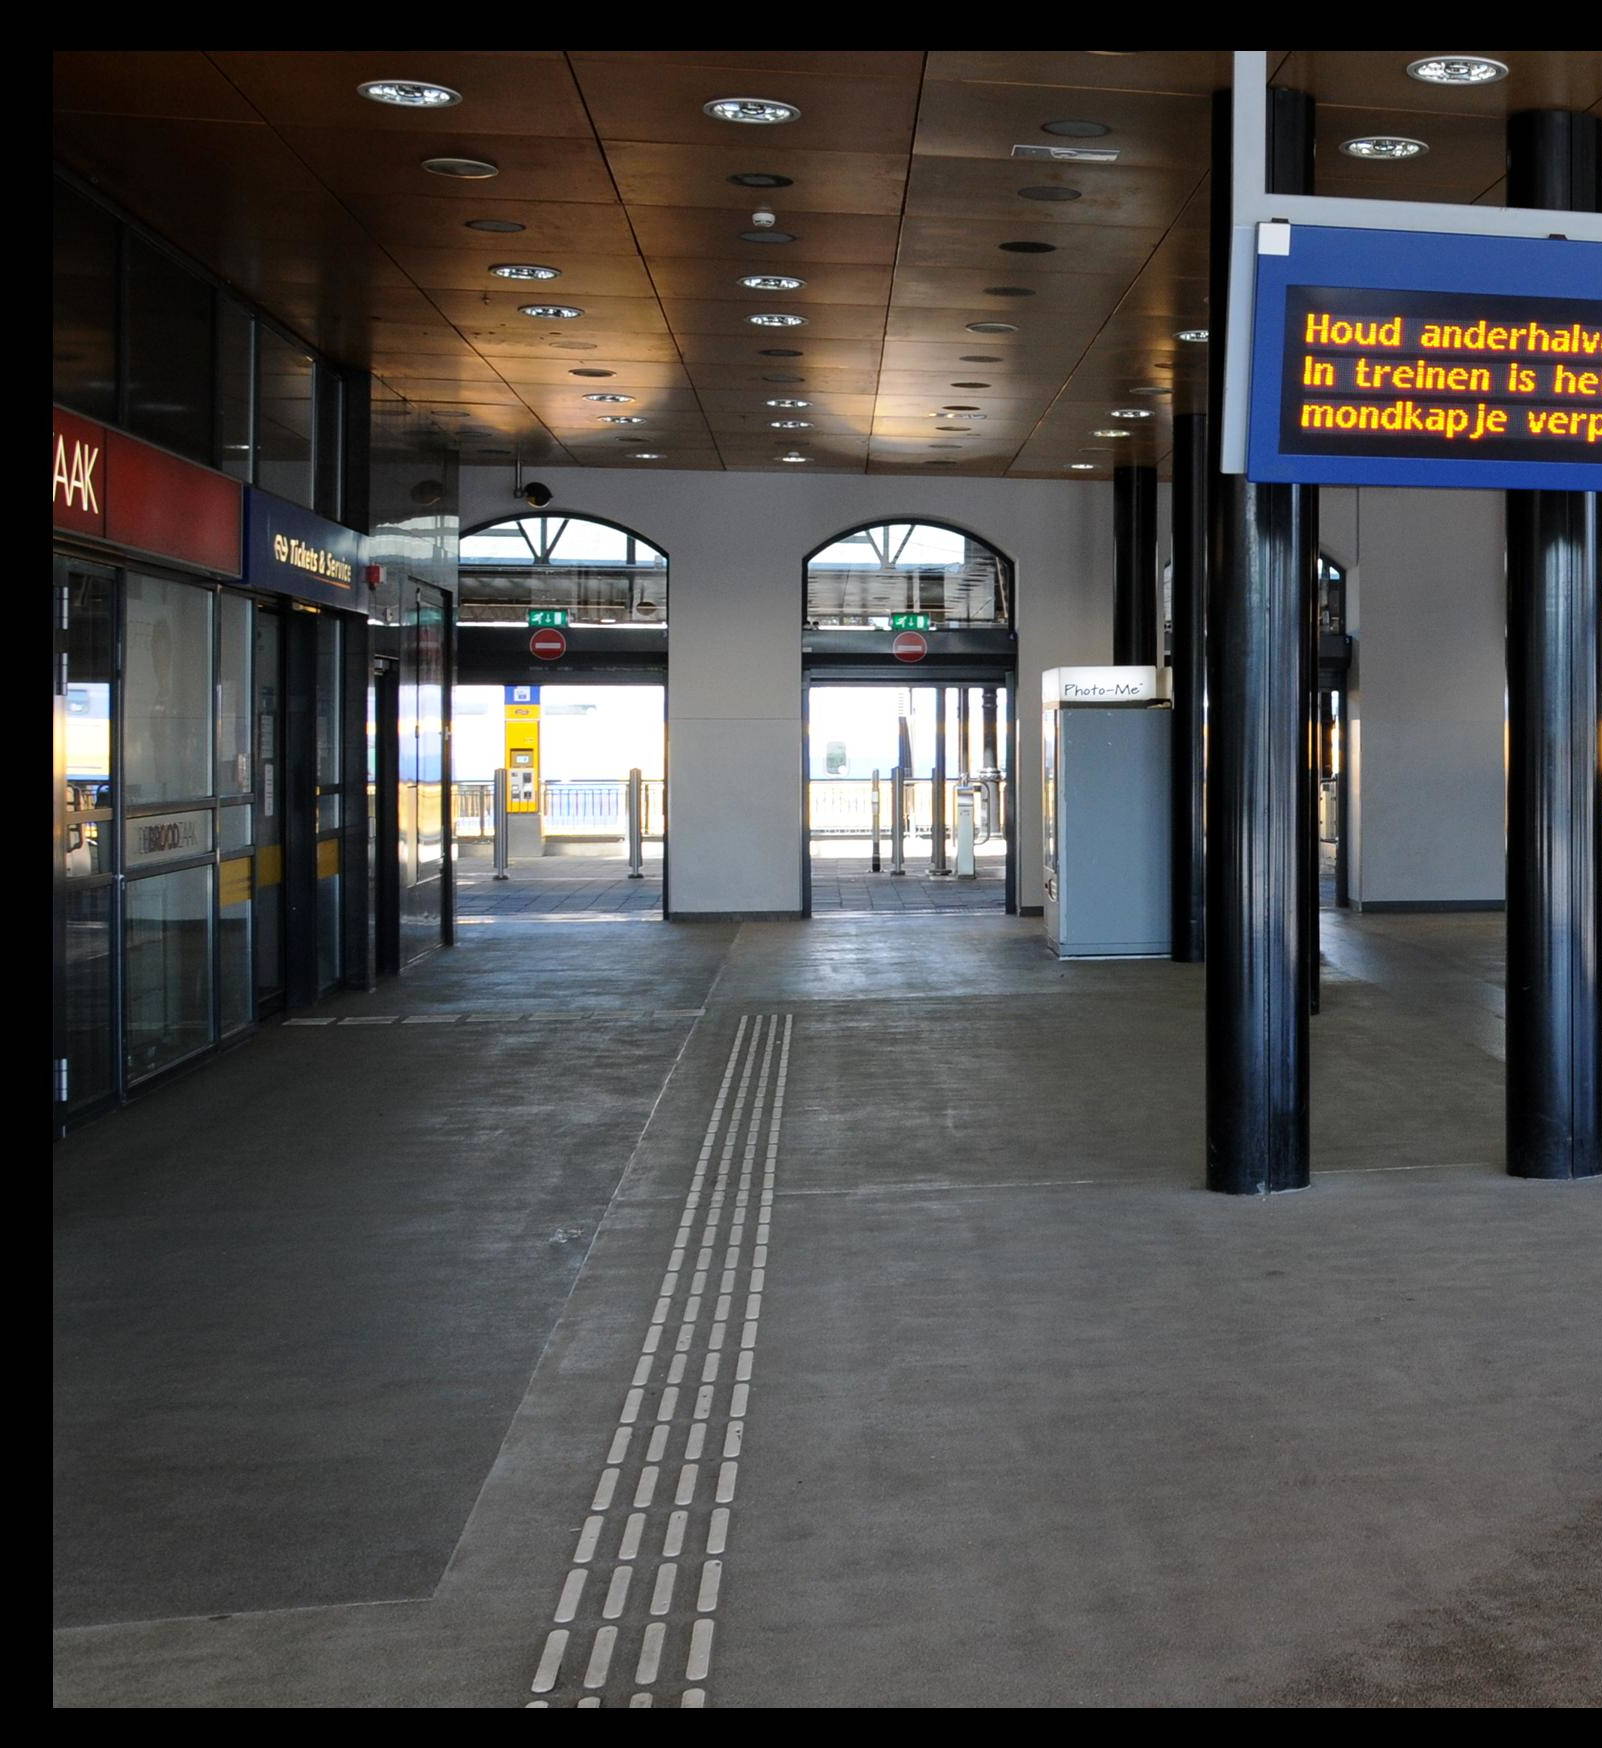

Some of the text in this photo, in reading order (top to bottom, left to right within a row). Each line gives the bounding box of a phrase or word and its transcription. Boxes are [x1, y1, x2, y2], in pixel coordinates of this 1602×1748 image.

[1304, 313, 1403, 347] Houd
[1302, 355, 1336, 387] In
[1354, 357, 1492, 392] treinen
[1506, 362, 1536, 394] is
[1300, 400, 1508, 440] mondkapje
[53, 434, 99, 514] AAK
[290, 539, 352, 582] Tickets & Service
[1064, 683, 1140, 697] Photo-Me
